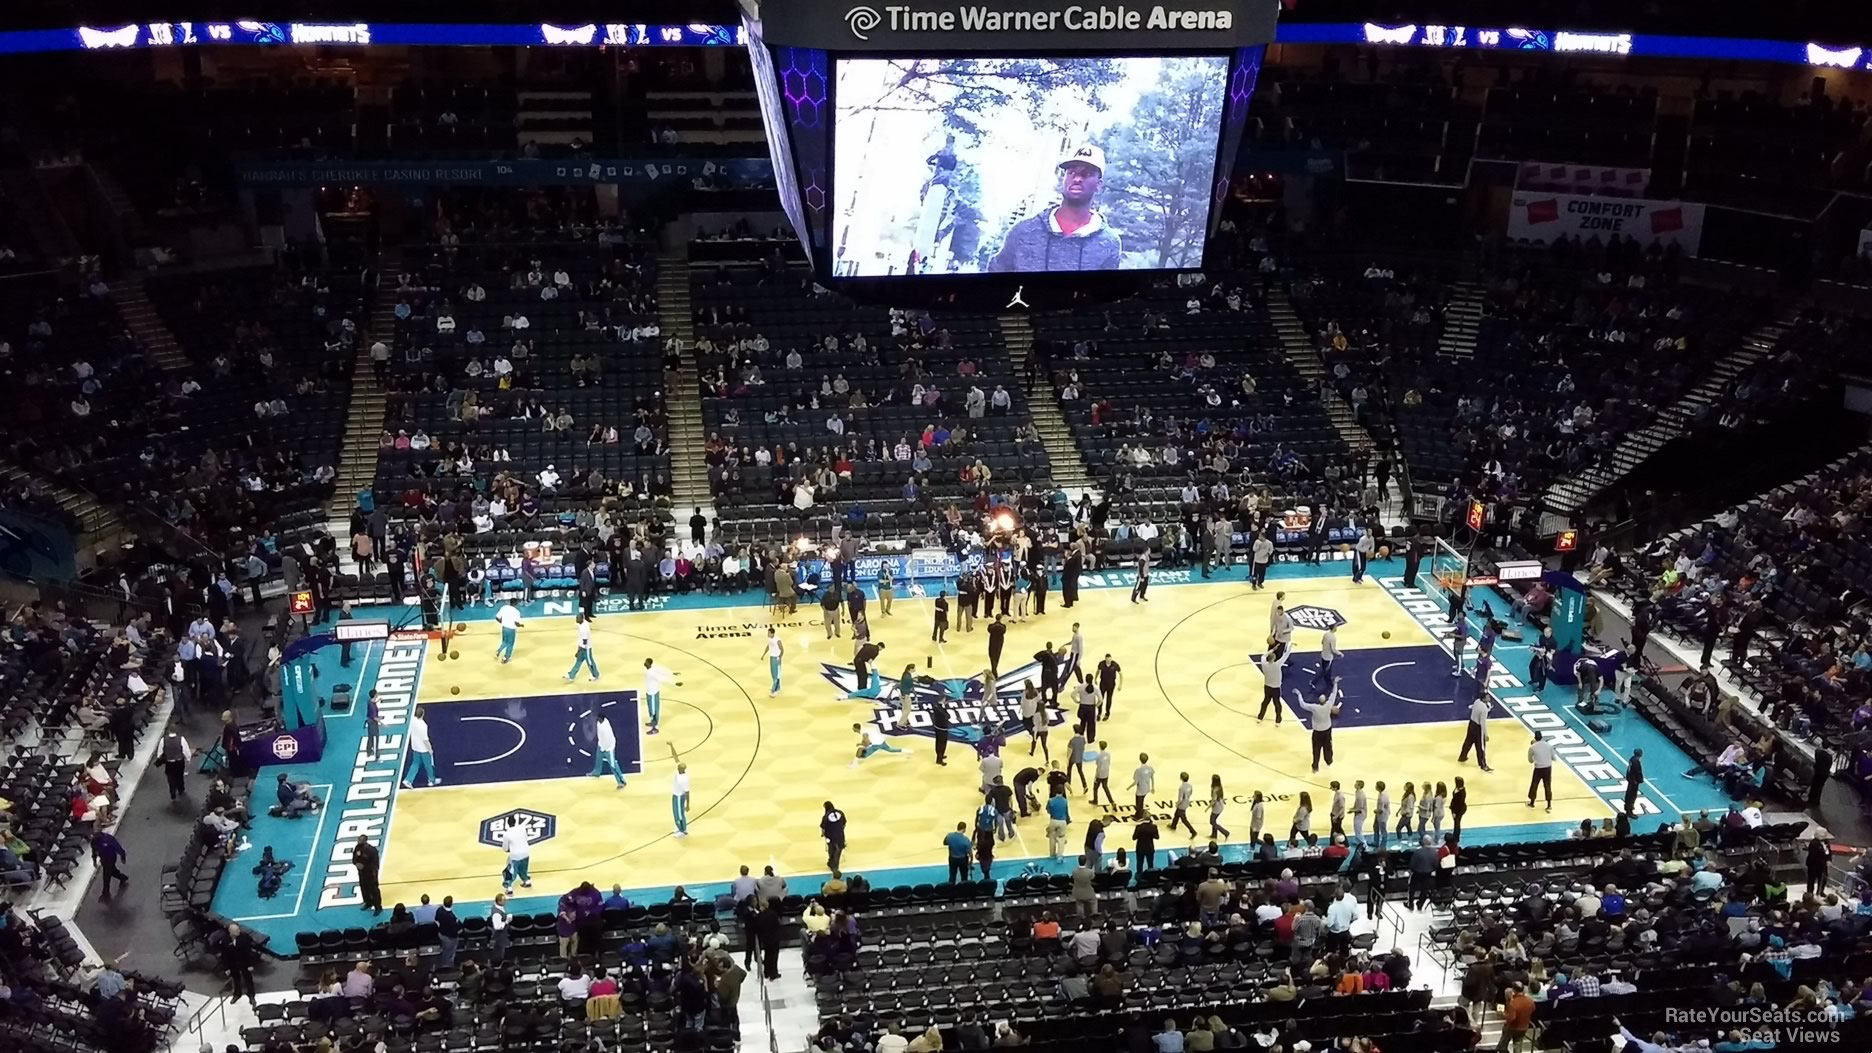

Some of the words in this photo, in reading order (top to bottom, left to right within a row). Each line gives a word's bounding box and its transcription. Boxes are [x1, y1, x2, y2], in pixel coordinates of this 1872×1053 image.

[885, 6, 955, 31] Time
[960, 6, 1060, 31] Warner
[1063, 5, 1141, 31] Cable
[1146, 6, 1233, 31] Arena
[208, 24, 231, 39] VS
[661, 27, 682, 41] VS
[1479, 30, 1500, 45] VS
[384, 168, 430, 180] CASINO
[435, 168, 482, 180] RESORT
[496, 165, 512, 175] 104
[1567, 200, 1646, 219] COMFORT
[1579, 216, 1624, 232] ZONE
[596, 603, 664, 613] HEATH
[1289, 607, 1334, 620] BUZZ
[696, 623, 737, 633] Time
[742, 621, 804, 630] Warner
[695, 630, 752, 640] Arena
[275, 743, 296, 751] CPI
